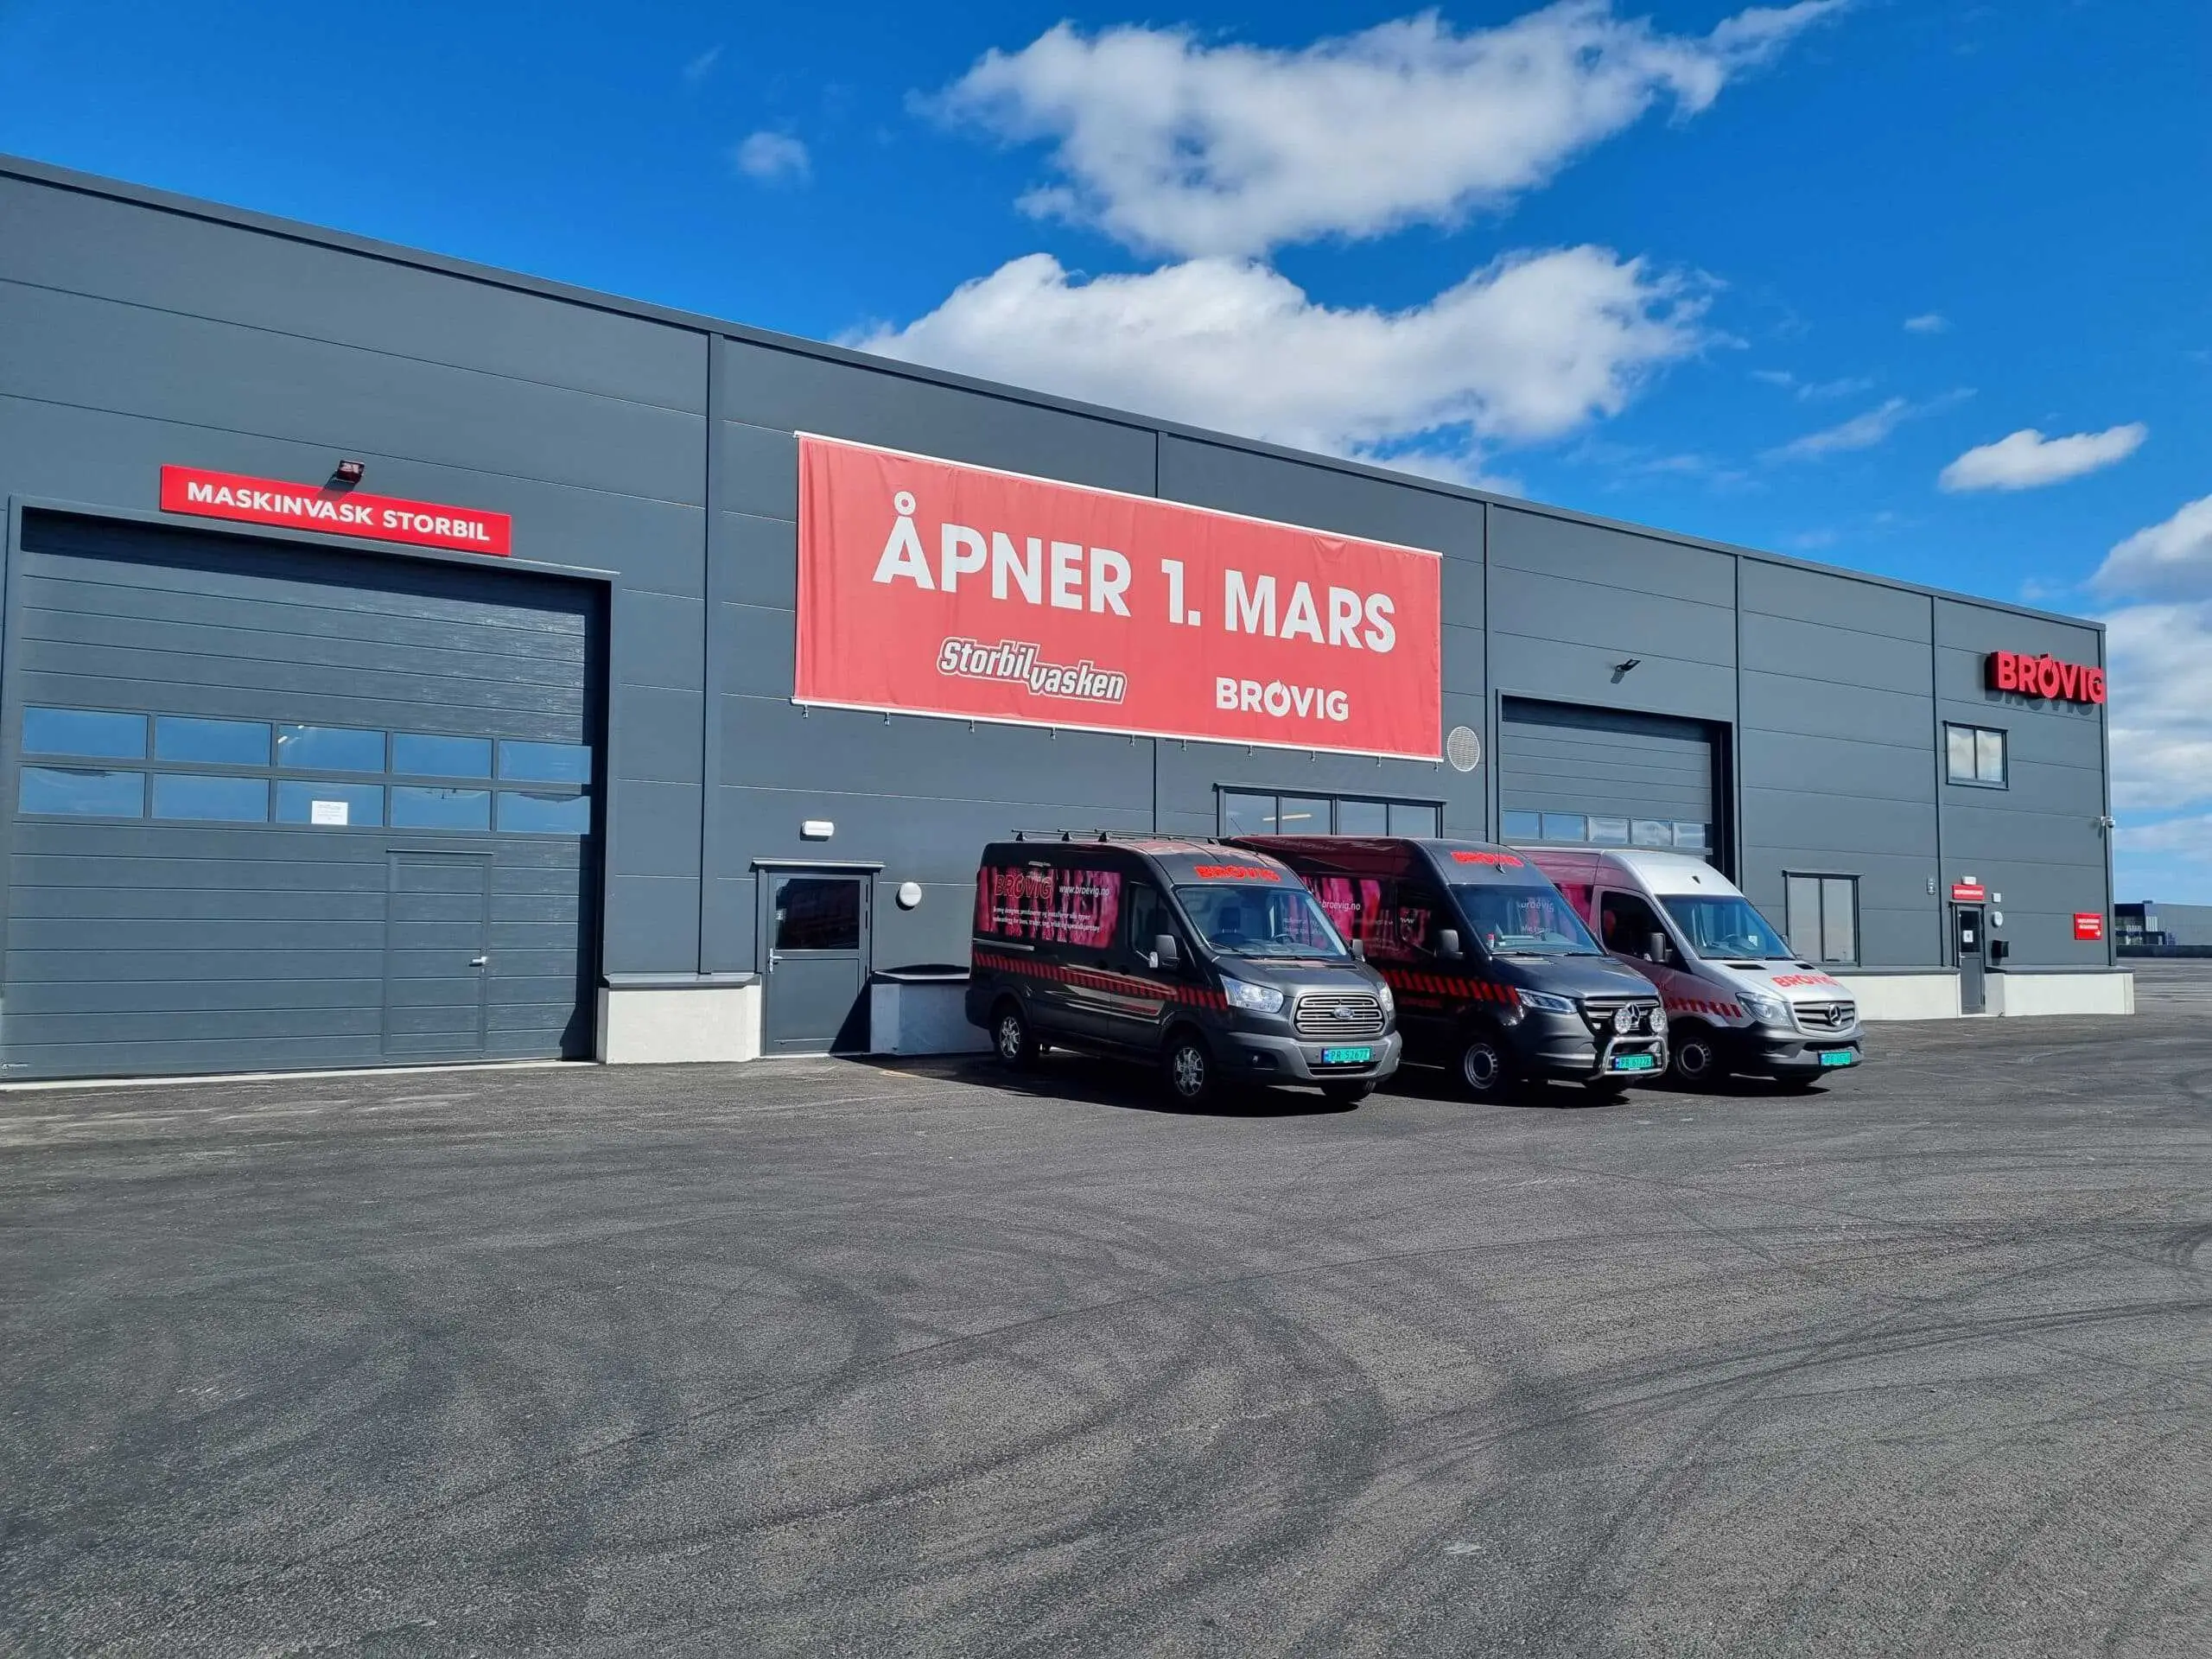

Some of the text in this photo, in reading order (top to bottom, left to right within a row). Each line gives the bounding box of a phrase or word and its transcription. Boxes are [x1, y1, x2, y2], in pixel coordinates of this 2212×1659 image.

[187, 481, 491, 542] MASKINVASK STORBIL
[872, 491, 1396, 653] ÅPNER 1. MARS
